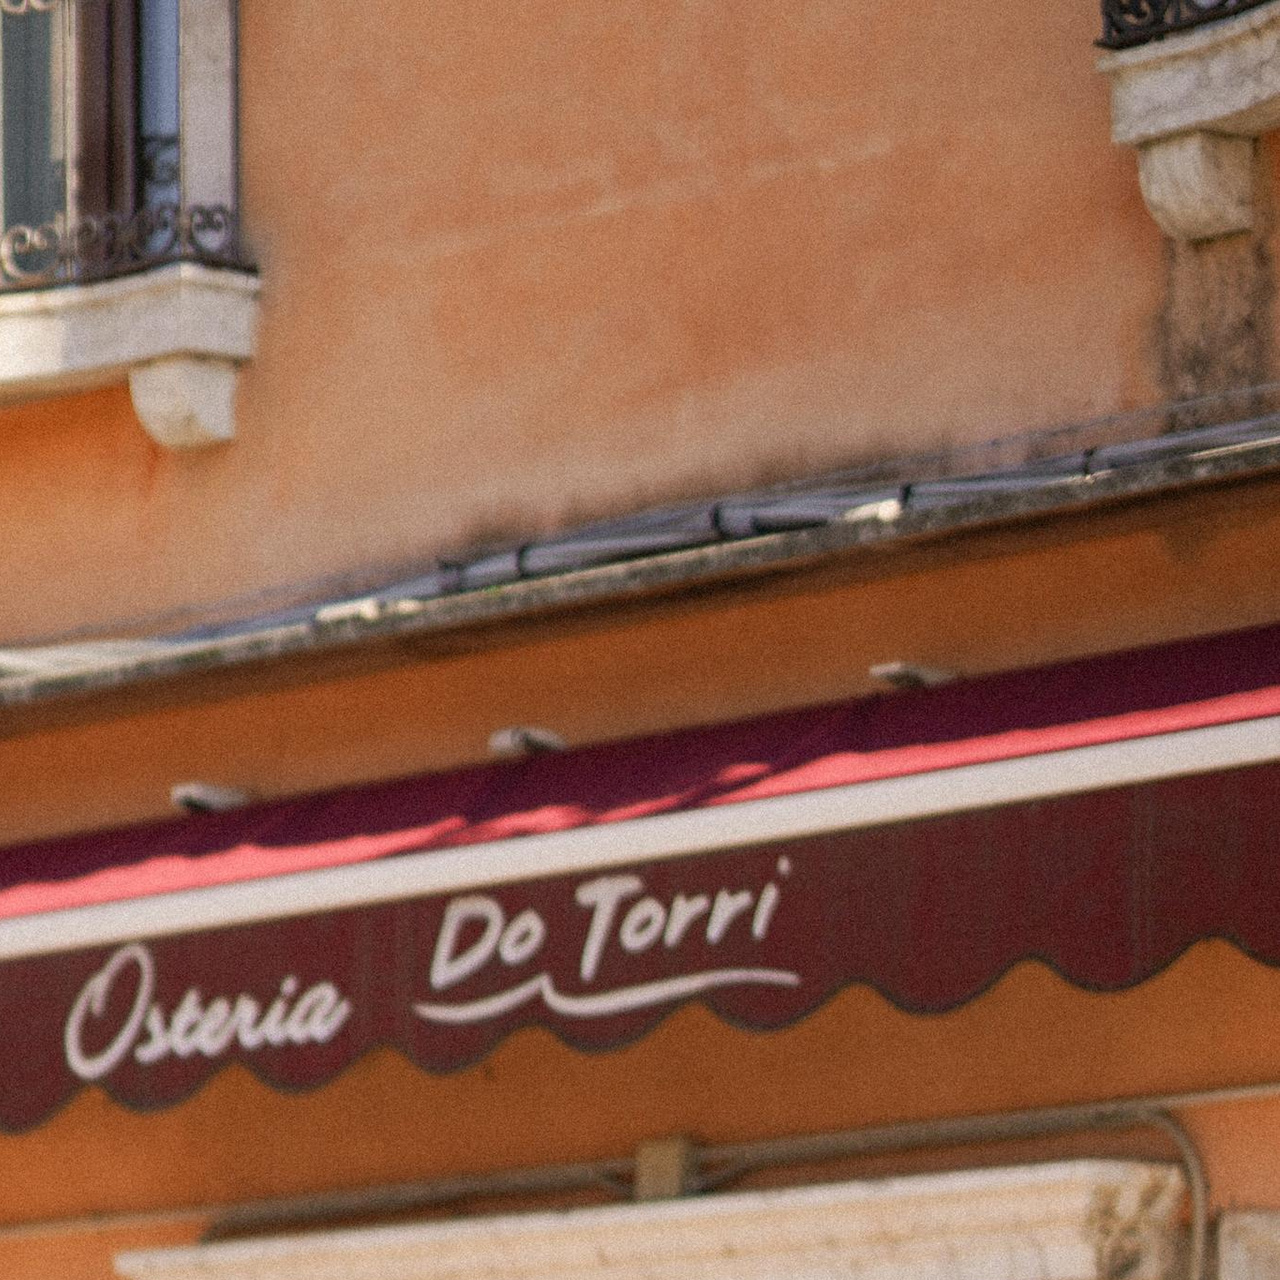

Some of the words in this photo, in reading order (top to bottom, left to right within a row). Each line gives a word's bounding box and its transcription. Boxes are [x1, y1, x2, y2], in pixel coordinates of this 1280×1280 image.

[64, 943, 351, 1080] Osteria
[429, 895, 546, 990] Do
[575, 857, 791, 982] Torri
